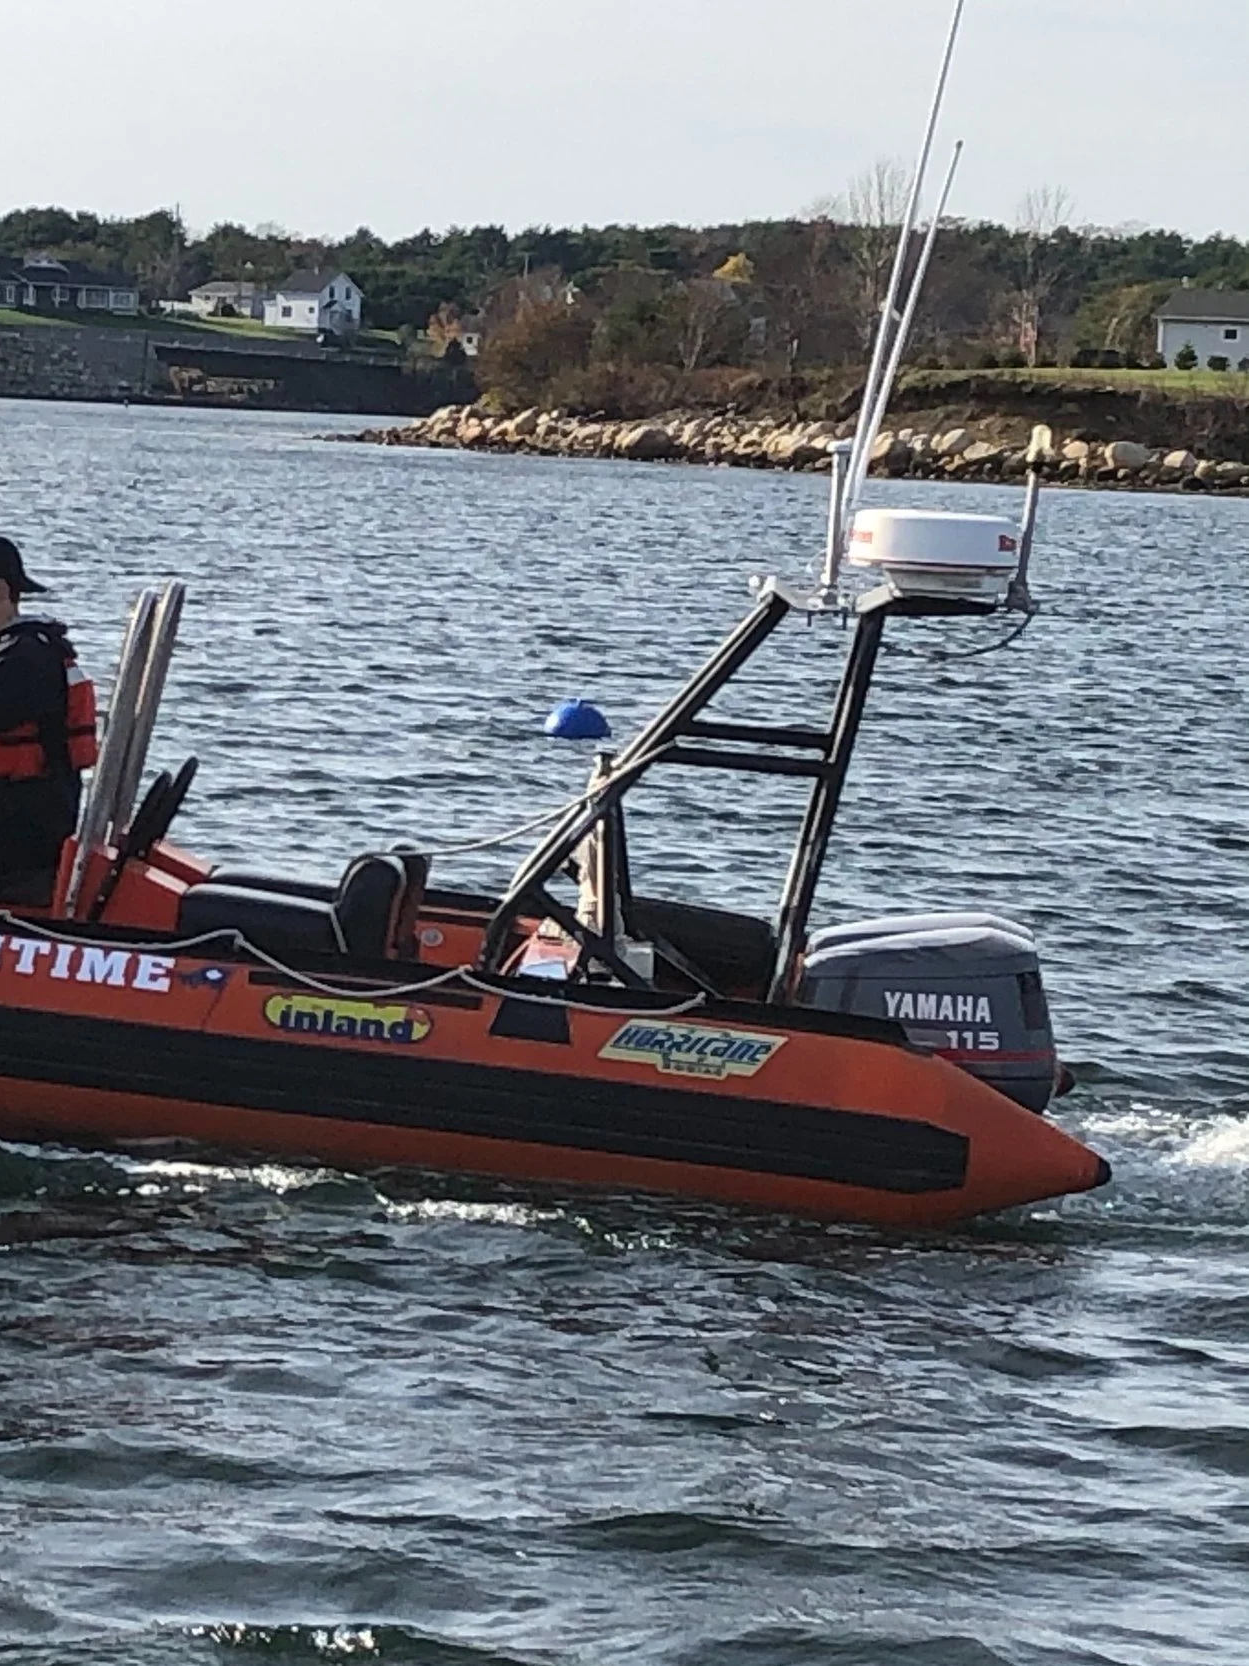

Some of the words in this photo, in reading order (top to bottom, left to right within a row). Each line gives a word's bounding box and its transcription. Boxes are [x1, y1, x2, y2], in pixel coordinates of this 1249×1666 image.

[279, 1004, 415, 1044] inland
[884, 991, 992, 1024] YAMAHA
[946, 1031, 1000, 1051] 115
